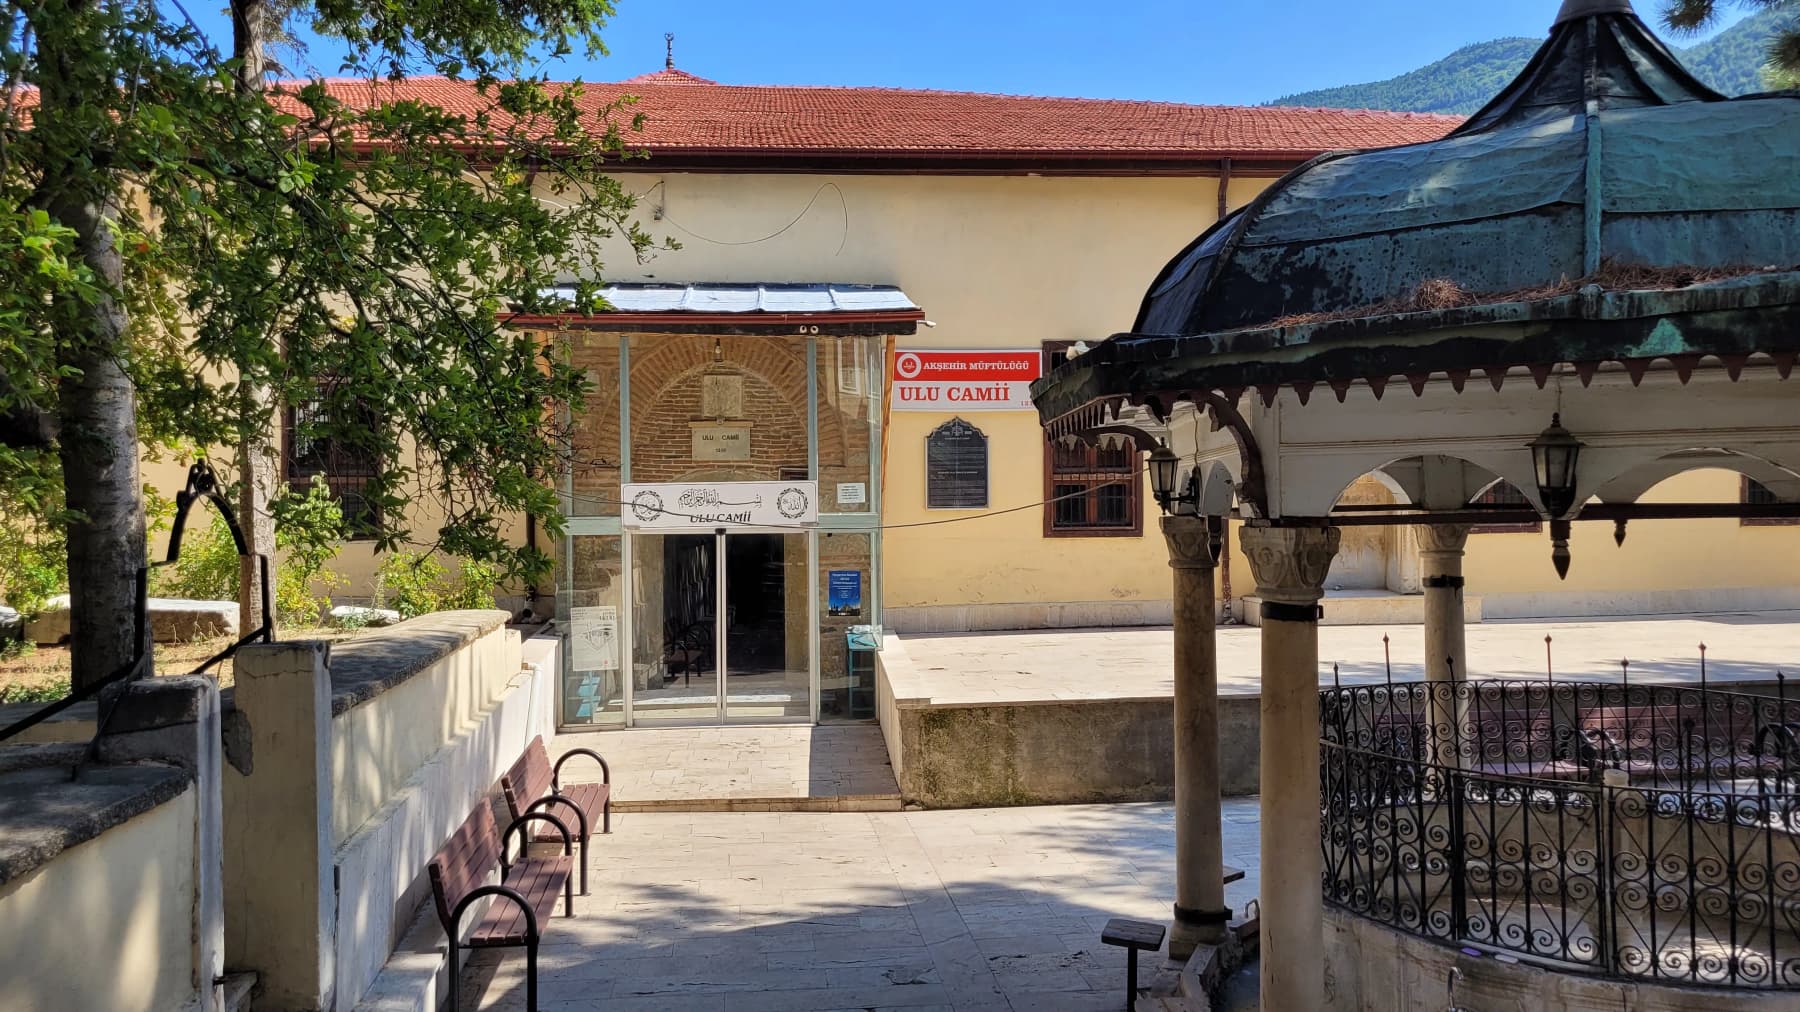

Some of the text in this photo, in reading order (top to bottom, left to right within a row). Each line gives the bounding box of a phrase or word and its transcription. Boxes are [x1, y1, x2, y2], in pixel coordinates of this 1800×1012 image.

[923, 360, 1029, 371] AKŞEHİR MÜFTÜLÜĞÜ
[899, 382, 1010, 401] ULU CAMİİ
[689, 510, 752, 523] ULU CAMİİ
